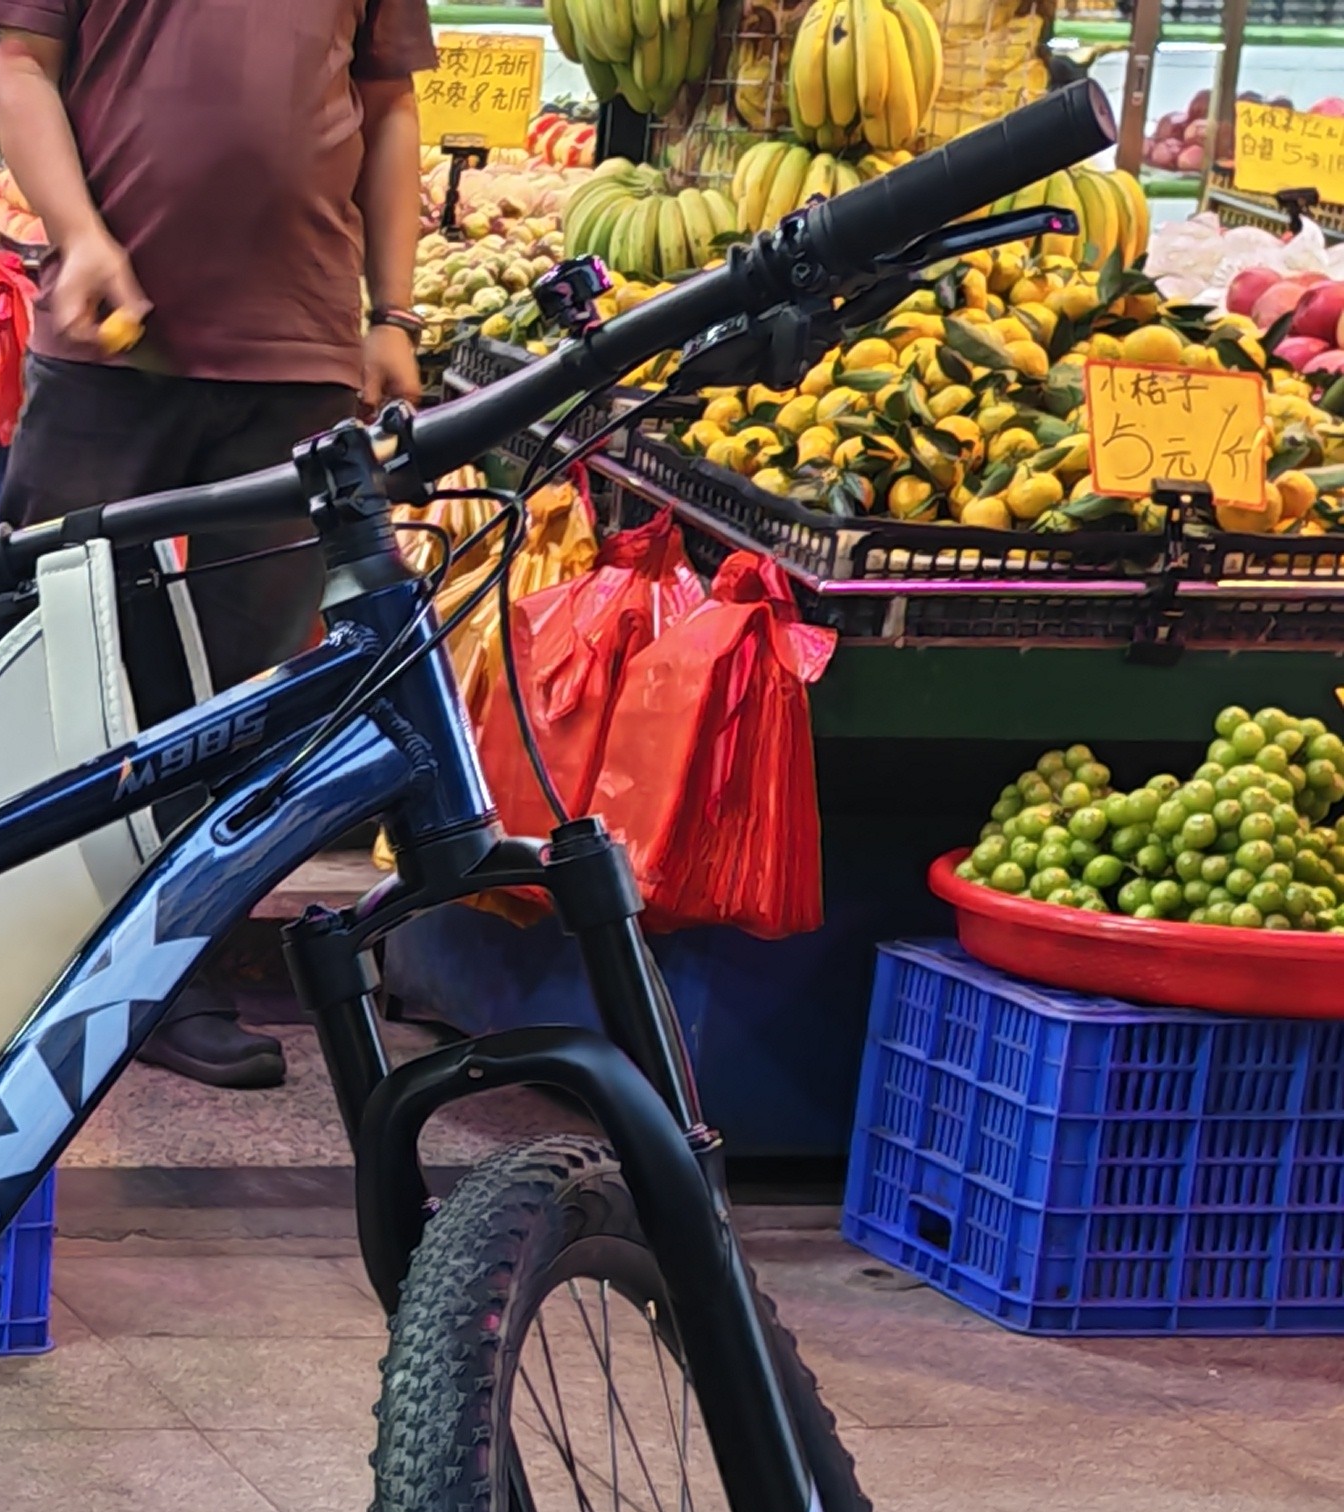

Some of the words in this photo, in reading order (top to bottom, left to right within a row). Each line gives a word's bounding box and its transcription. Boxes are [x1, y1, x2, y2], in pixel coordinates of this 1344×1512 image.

[1099, 365, 1210, 414] 小桔子
[1101, 403, 1252, 483] 5元/斤
